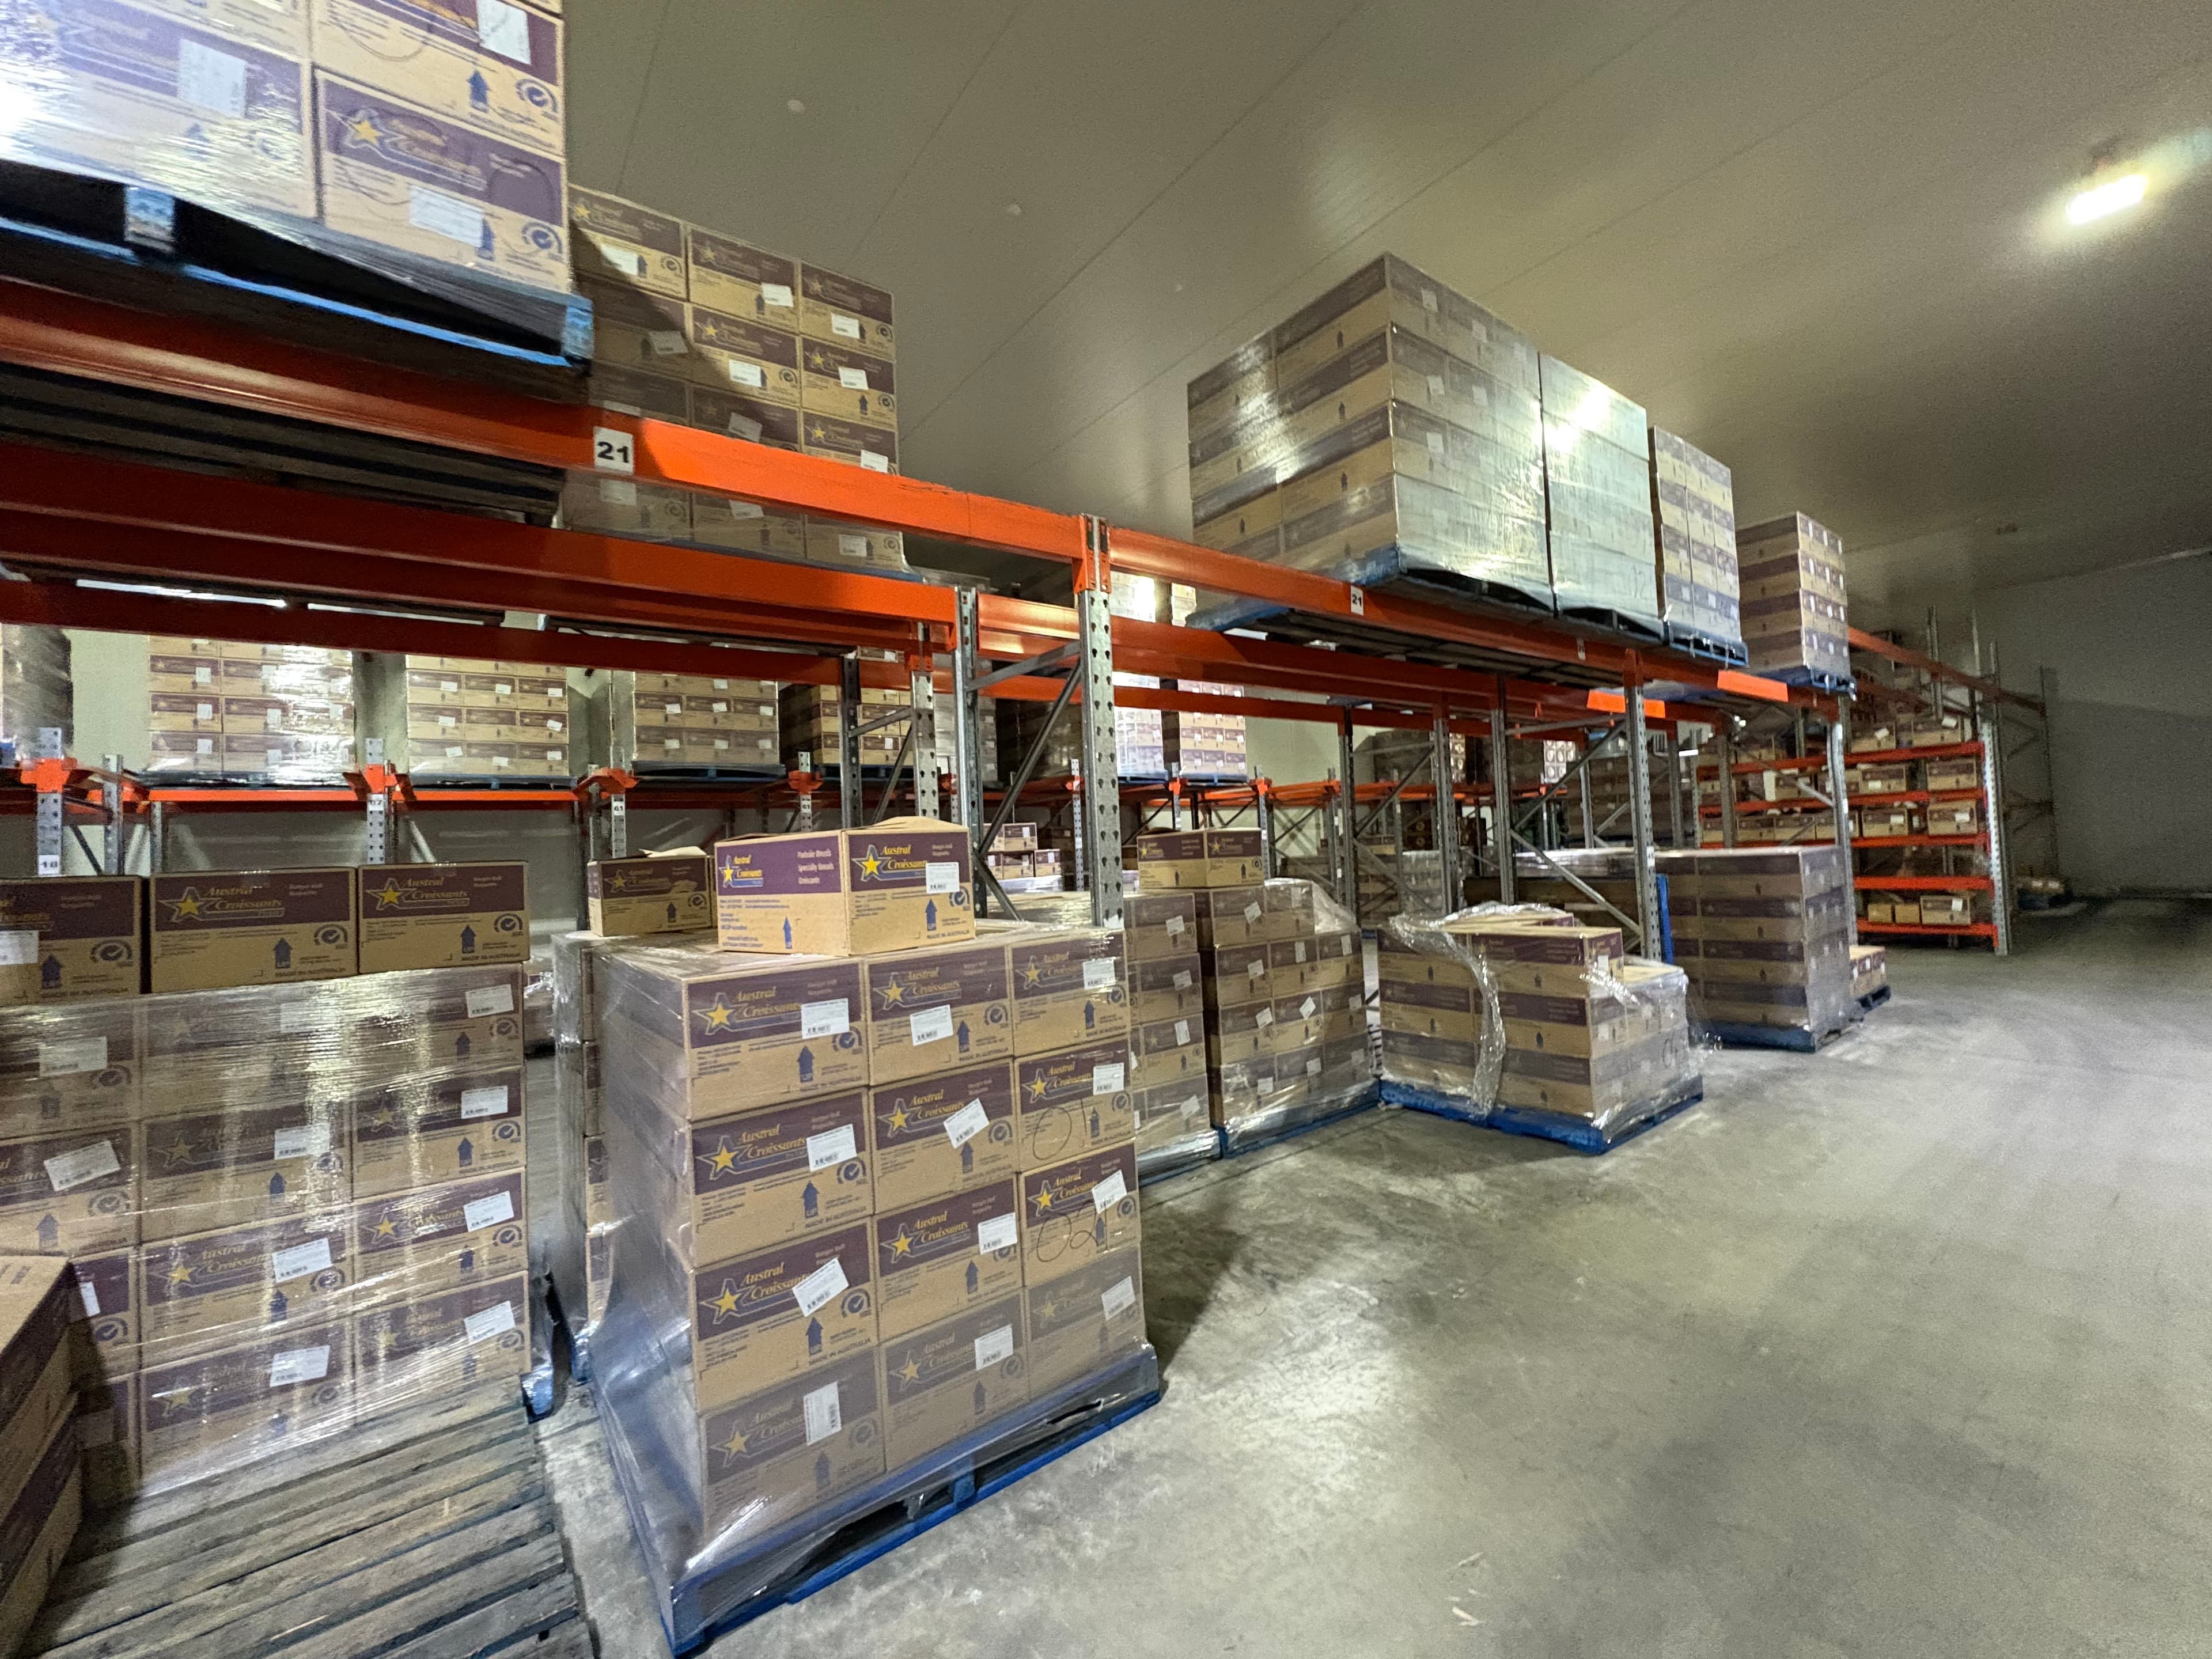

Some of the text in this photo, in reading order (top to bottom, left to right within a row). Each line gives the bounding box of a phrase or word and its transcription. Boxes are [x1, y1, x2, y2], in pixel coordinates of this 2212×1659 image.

[597, 441, 629, 463] 21
[1352, 594, 1362, 607] 21
[882, 844, 911, 855] Austral
[888, 859, 929, 869] Croissant
[404, 877, 444, 886] Austral
[206, 887, 253, 896] Austral
[411, 891, 467, 900] Croissants
[215, 900, 281, 910] Croissants
[733, 986, 777, 1002] Austral
[912, 981, 960, 995] Croissants
[1049, 1061, 1075, 1075] Austral
[911, 1089, 944, 1106] Austral
[737, 1124, 781, 1145] Austral
[748, 1137, 806, 1158] Croissants
[915, 1211, 948, 1229] Austral
[921, 1222, 968, 1243] Croissants
[741, 1262, 785, 1286] Austral
